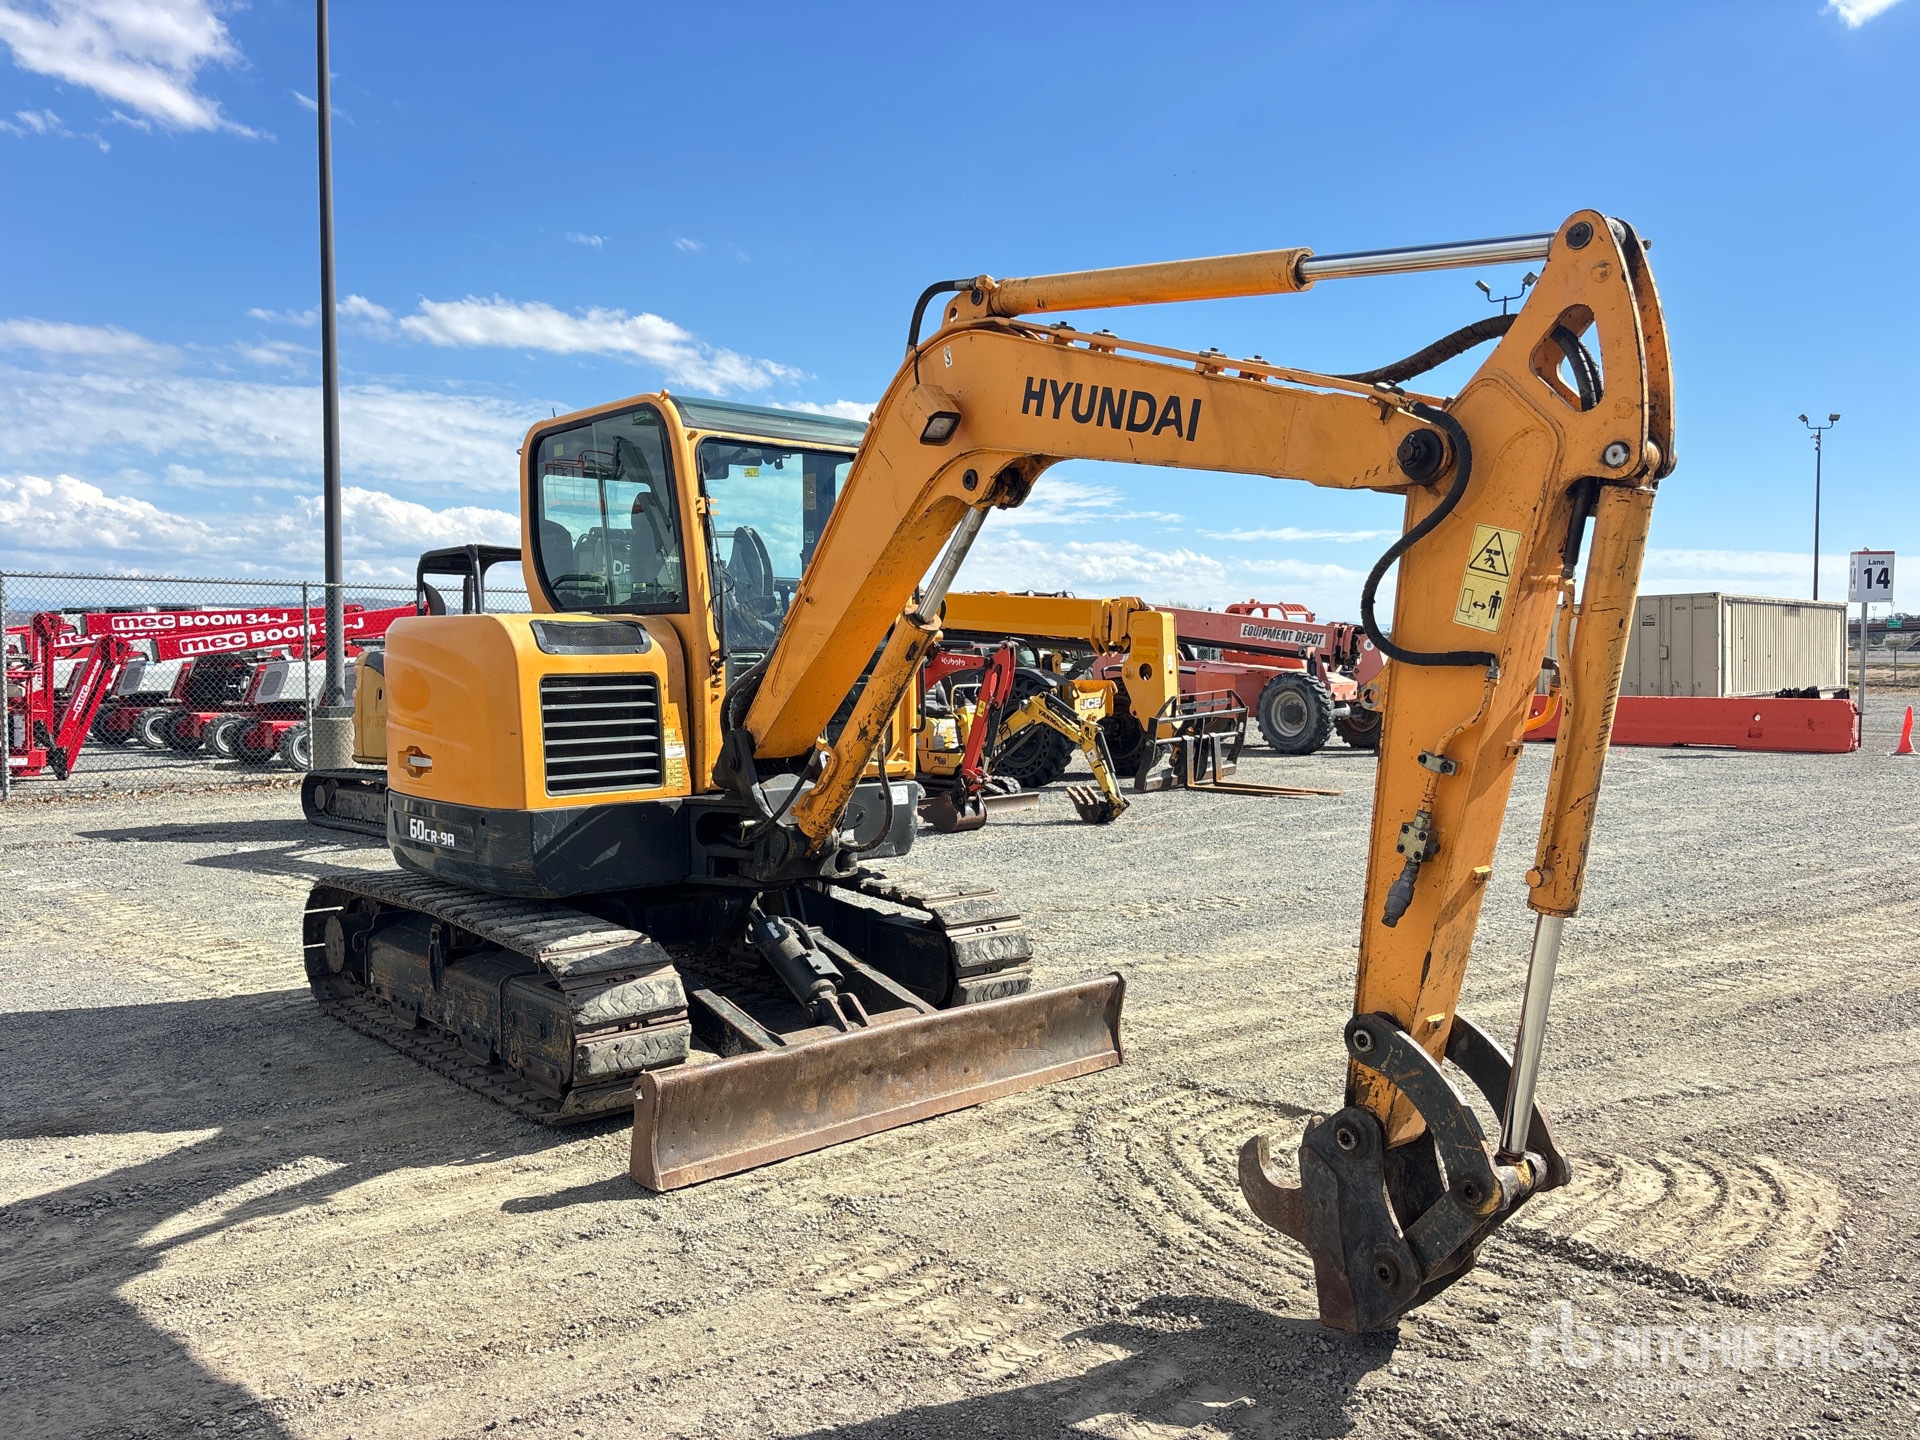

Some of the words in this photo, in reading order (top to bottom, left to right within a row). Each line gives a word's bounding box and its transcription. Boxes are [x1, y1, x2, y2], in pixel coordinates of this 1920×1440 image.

[1022, 376, 1202, 442] HYUNDAI
[1863, 567, 1891, 590] 14
[112, 616, 175, 630] mec
[179, 613, 243, 626] BOOM
[246, 612, 289, 625] 34-J
[180, 632, 248, 654] mec
[1242, 623, 1294, 642] EQUIPMENT
[1295, 632, 1325, 647] DEPOT
[941, 656, 966, 666] Kubota
[1080, 697, 1102, 710] JCB
